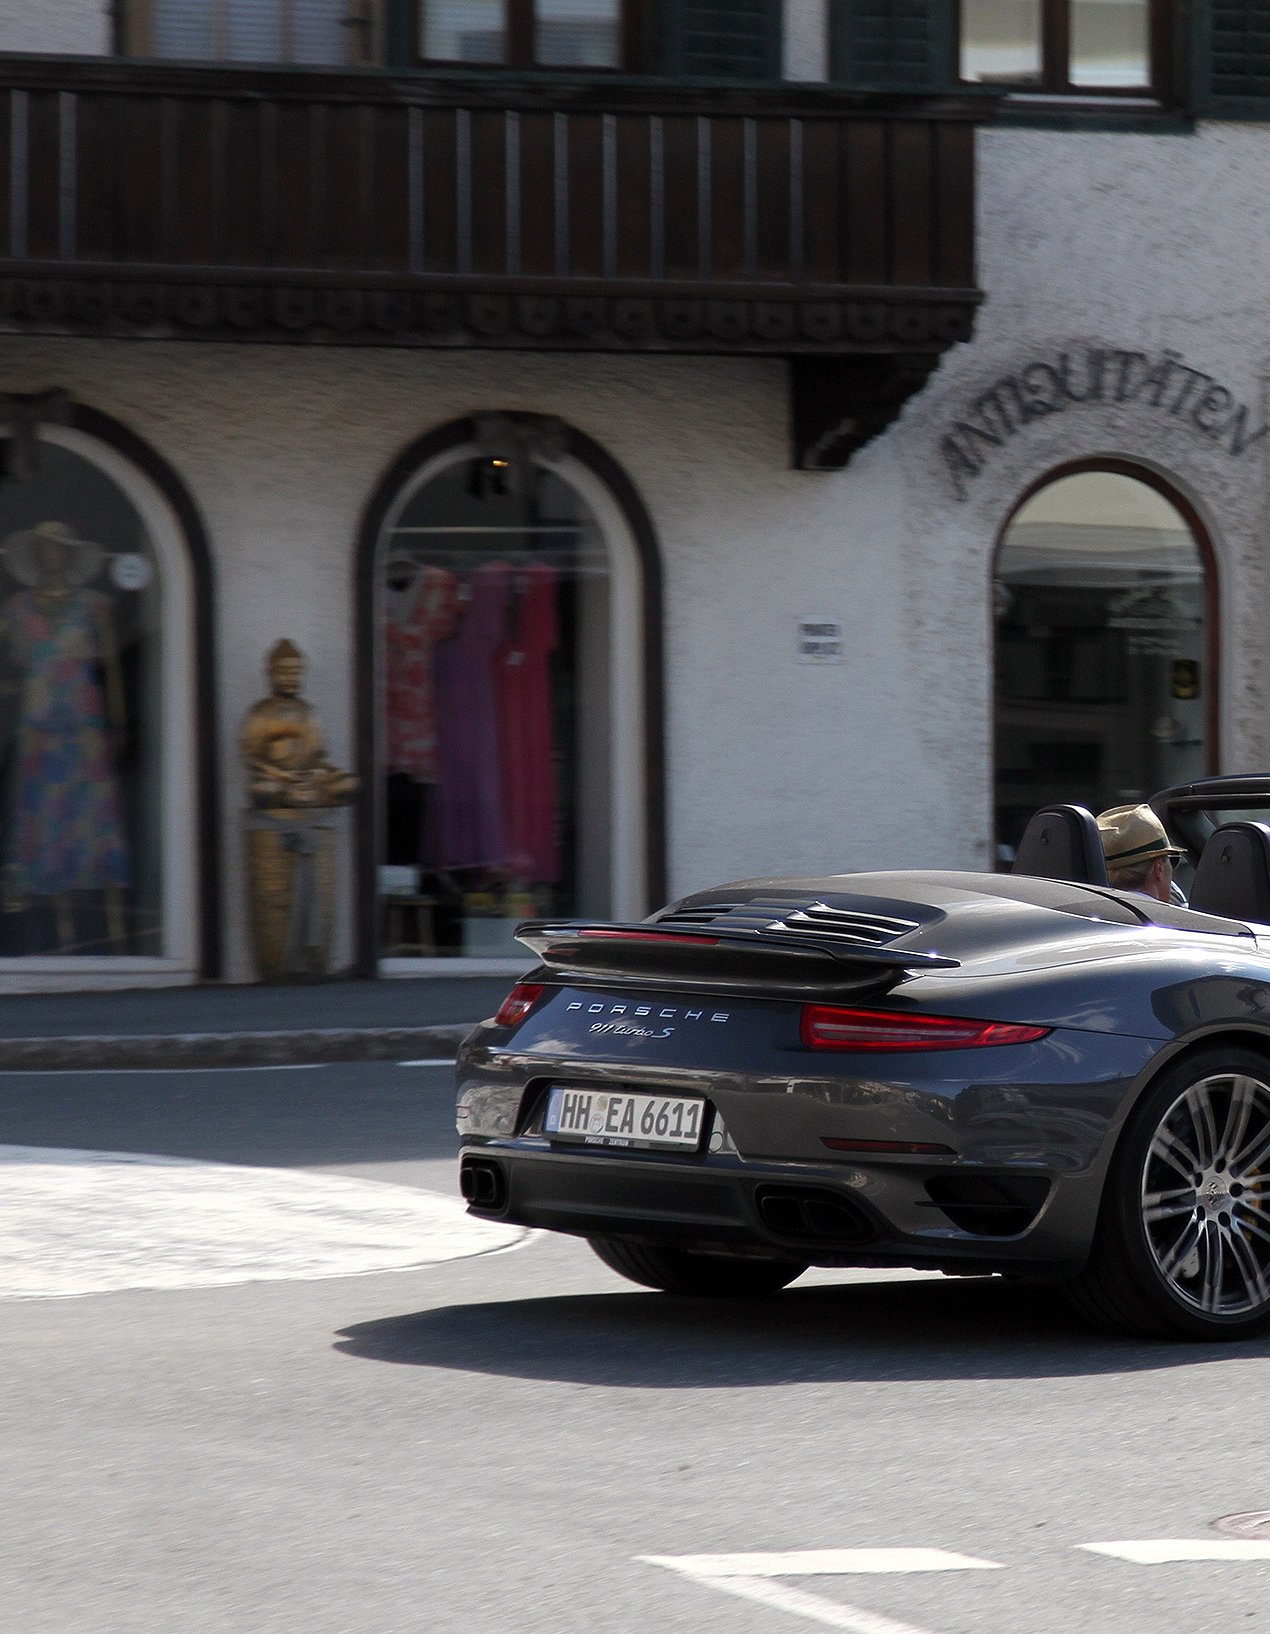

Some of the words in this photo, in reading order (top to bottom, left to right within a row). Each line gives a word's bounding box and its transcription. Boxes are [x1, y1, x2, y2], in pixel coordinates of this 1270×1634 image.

[566, 1002, 730, 1023] PORSCHE
[588, 1022, 615, 1034] 911
[560, 1093, 592, 1130] HH
[605, 1096, 635, 1134] EA
[640, 1100, 700, 1139] 6611
